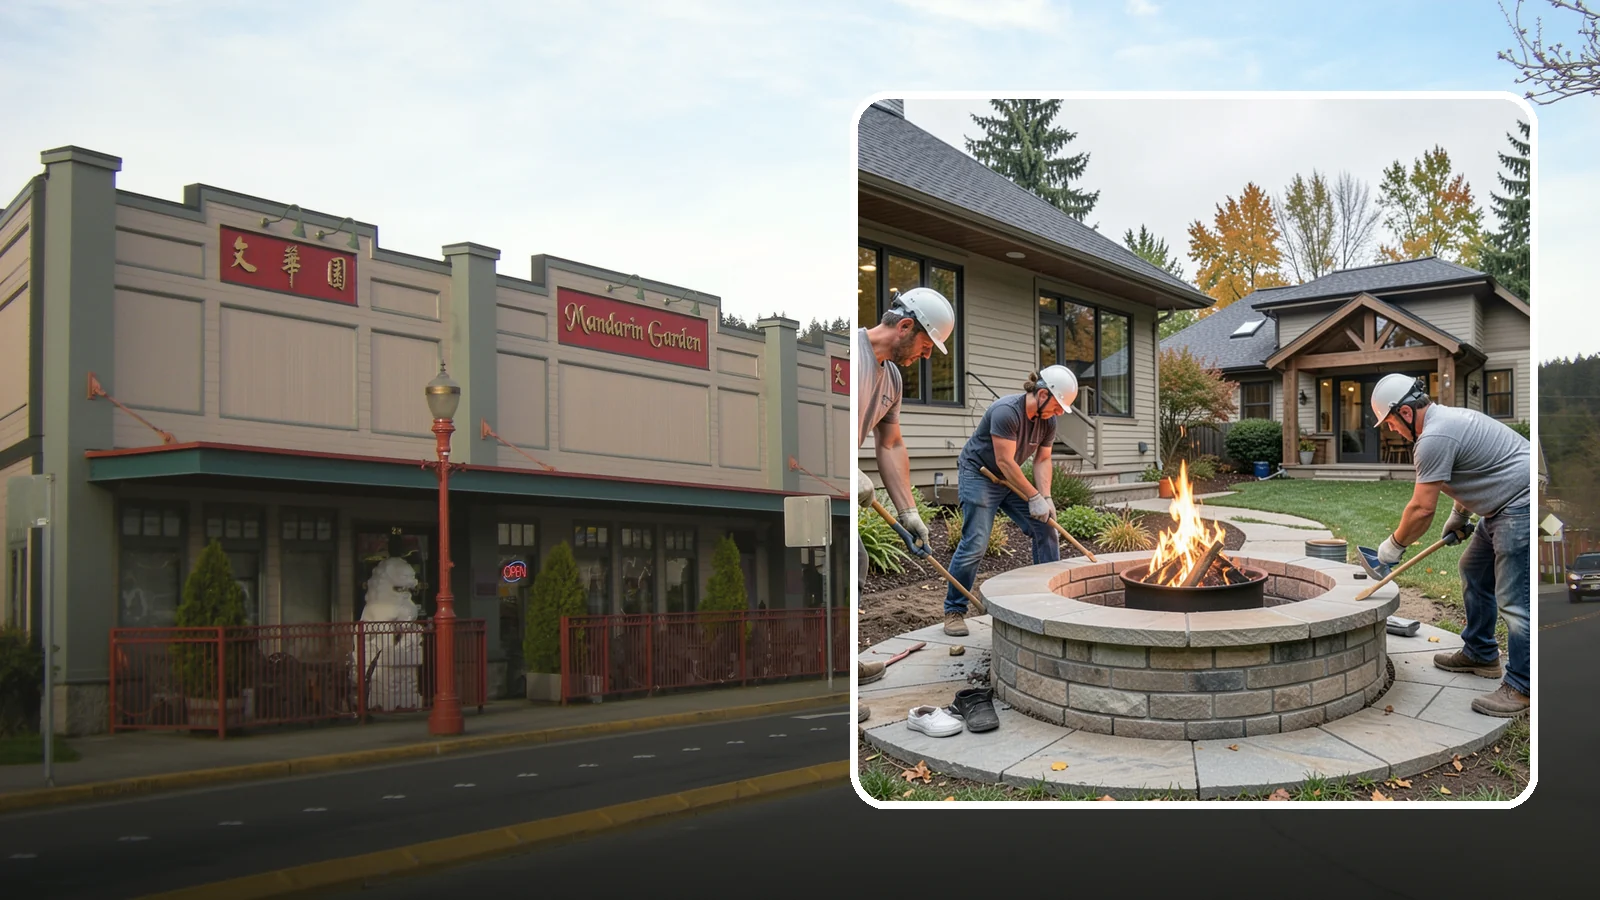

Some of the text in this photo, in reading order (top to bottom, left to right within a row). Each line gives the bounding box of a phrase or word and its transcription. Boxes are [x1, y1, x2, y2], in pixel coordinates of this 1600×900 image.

[231, 236, 346, 290] 文華園
[564, 302, 701, 352] Mandarin Garden
[503, 565, 527, 578] OPEN
